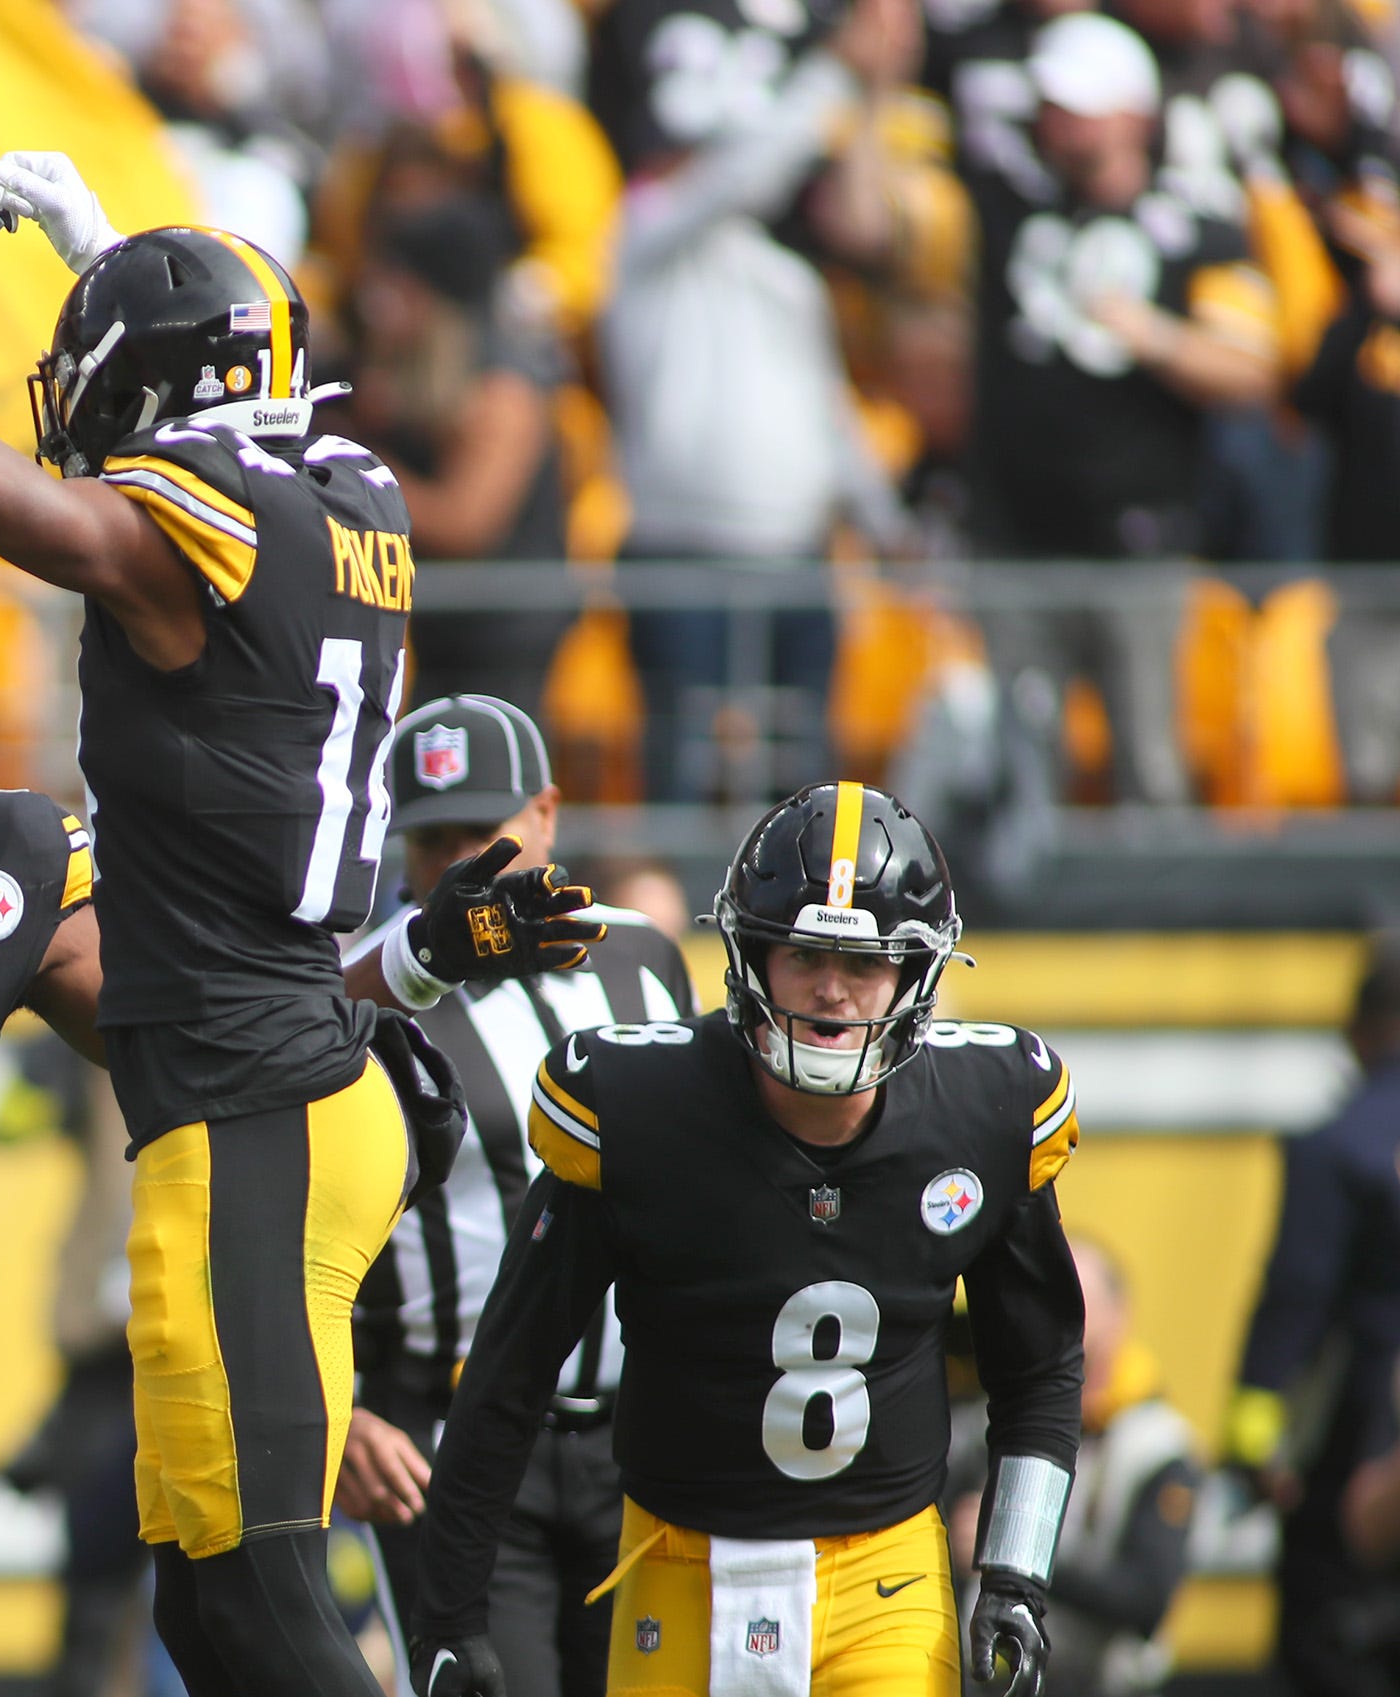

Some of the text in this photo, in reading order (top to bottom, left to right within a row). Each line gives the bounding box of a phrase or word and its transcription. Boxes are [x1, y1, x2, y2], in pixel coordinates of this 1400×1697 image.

[234, 367, 246, 390] 3
[196, 384, 223, 394] CATCH
[253, 407, 299, 427] Steelers
[326, 514, 416, 612] PICKEN
[829, 858, 855, 907] 8
[816, 909, 859, 925] Steelers
[814, 1201, 835, 1217] NFL
[762, 1280, 880, 1480] 8
[750, 1634, 776, 1653] NFL
